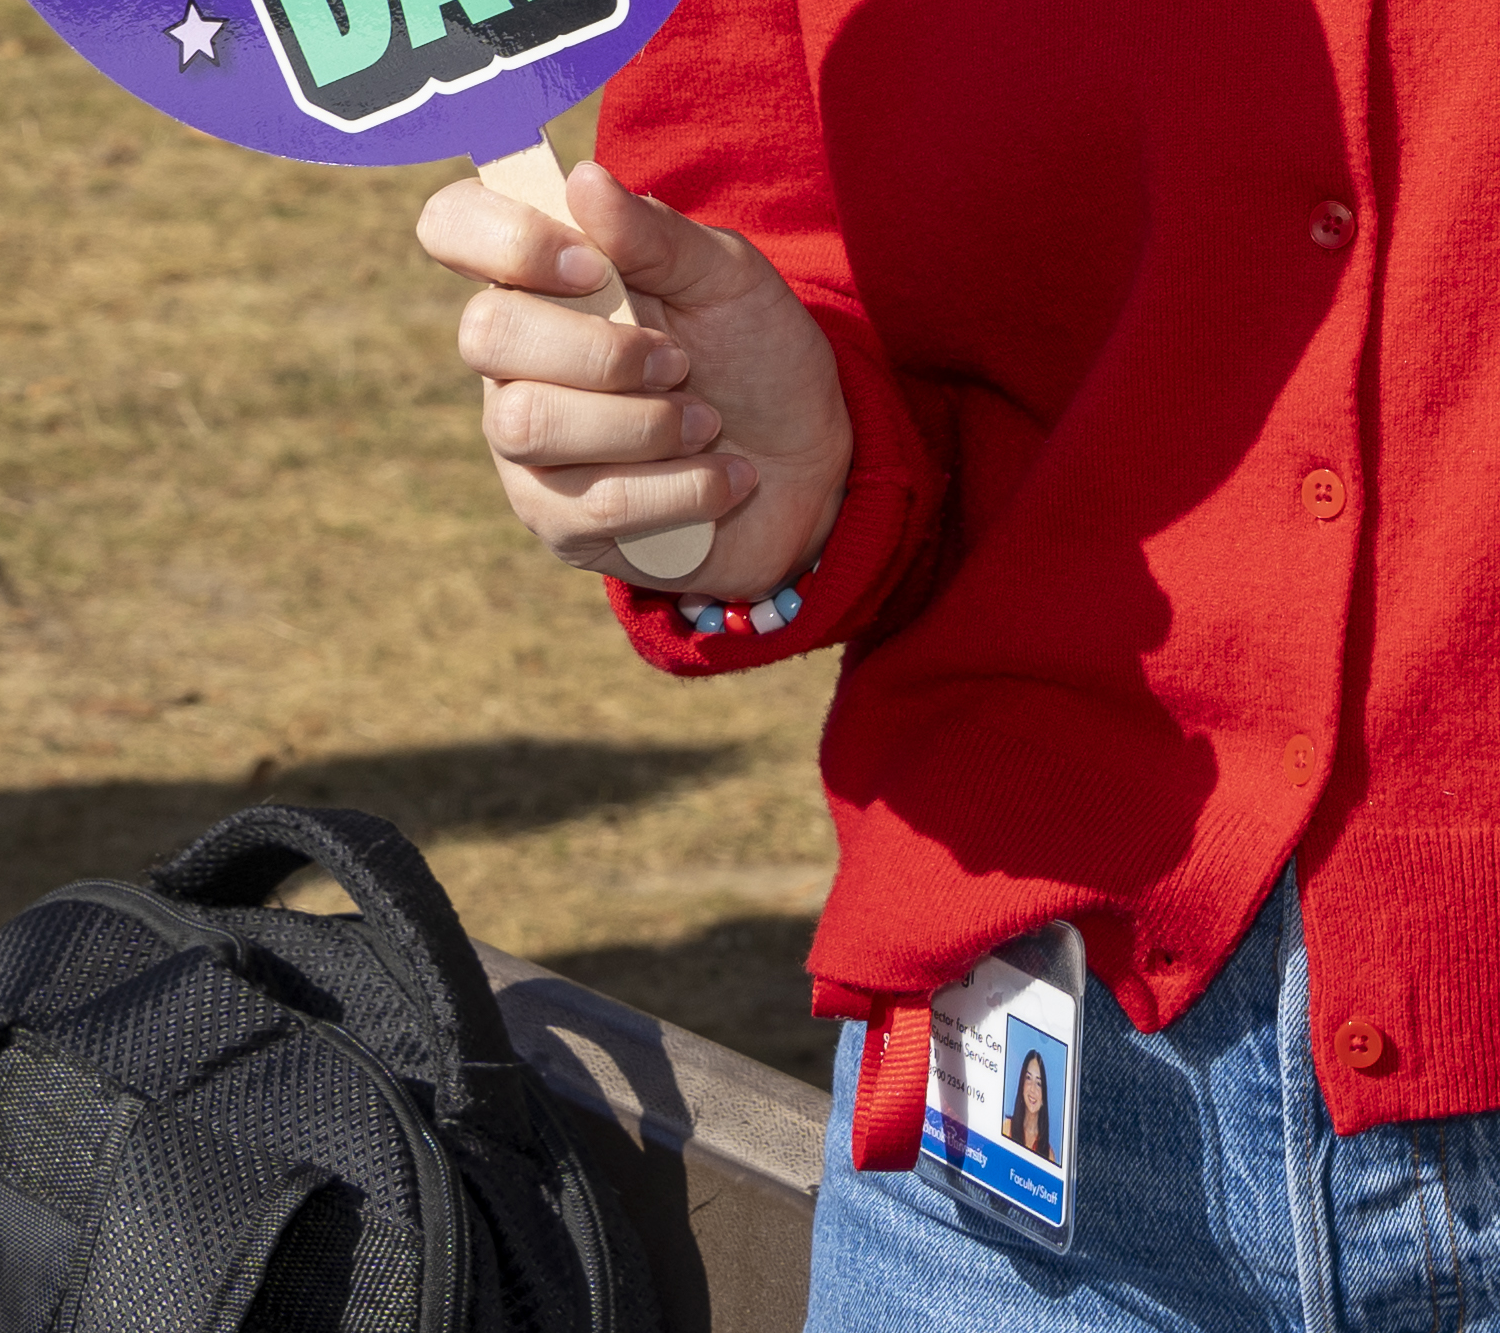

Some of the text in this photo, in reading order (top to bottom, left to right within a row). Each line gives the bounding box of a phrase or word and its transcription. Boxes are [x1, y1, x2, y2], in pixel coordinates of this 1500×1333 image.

[956, 1017, 968, 1033] for
[970, 1025, 983, 1043] the
[931, 1024, 962, 1053] Student
[964, 1042, 998, 1073] Services
[966, 1085, 985, 1103] 0196
[1009, 1168, 1058, 1205] Faculty/Staff
